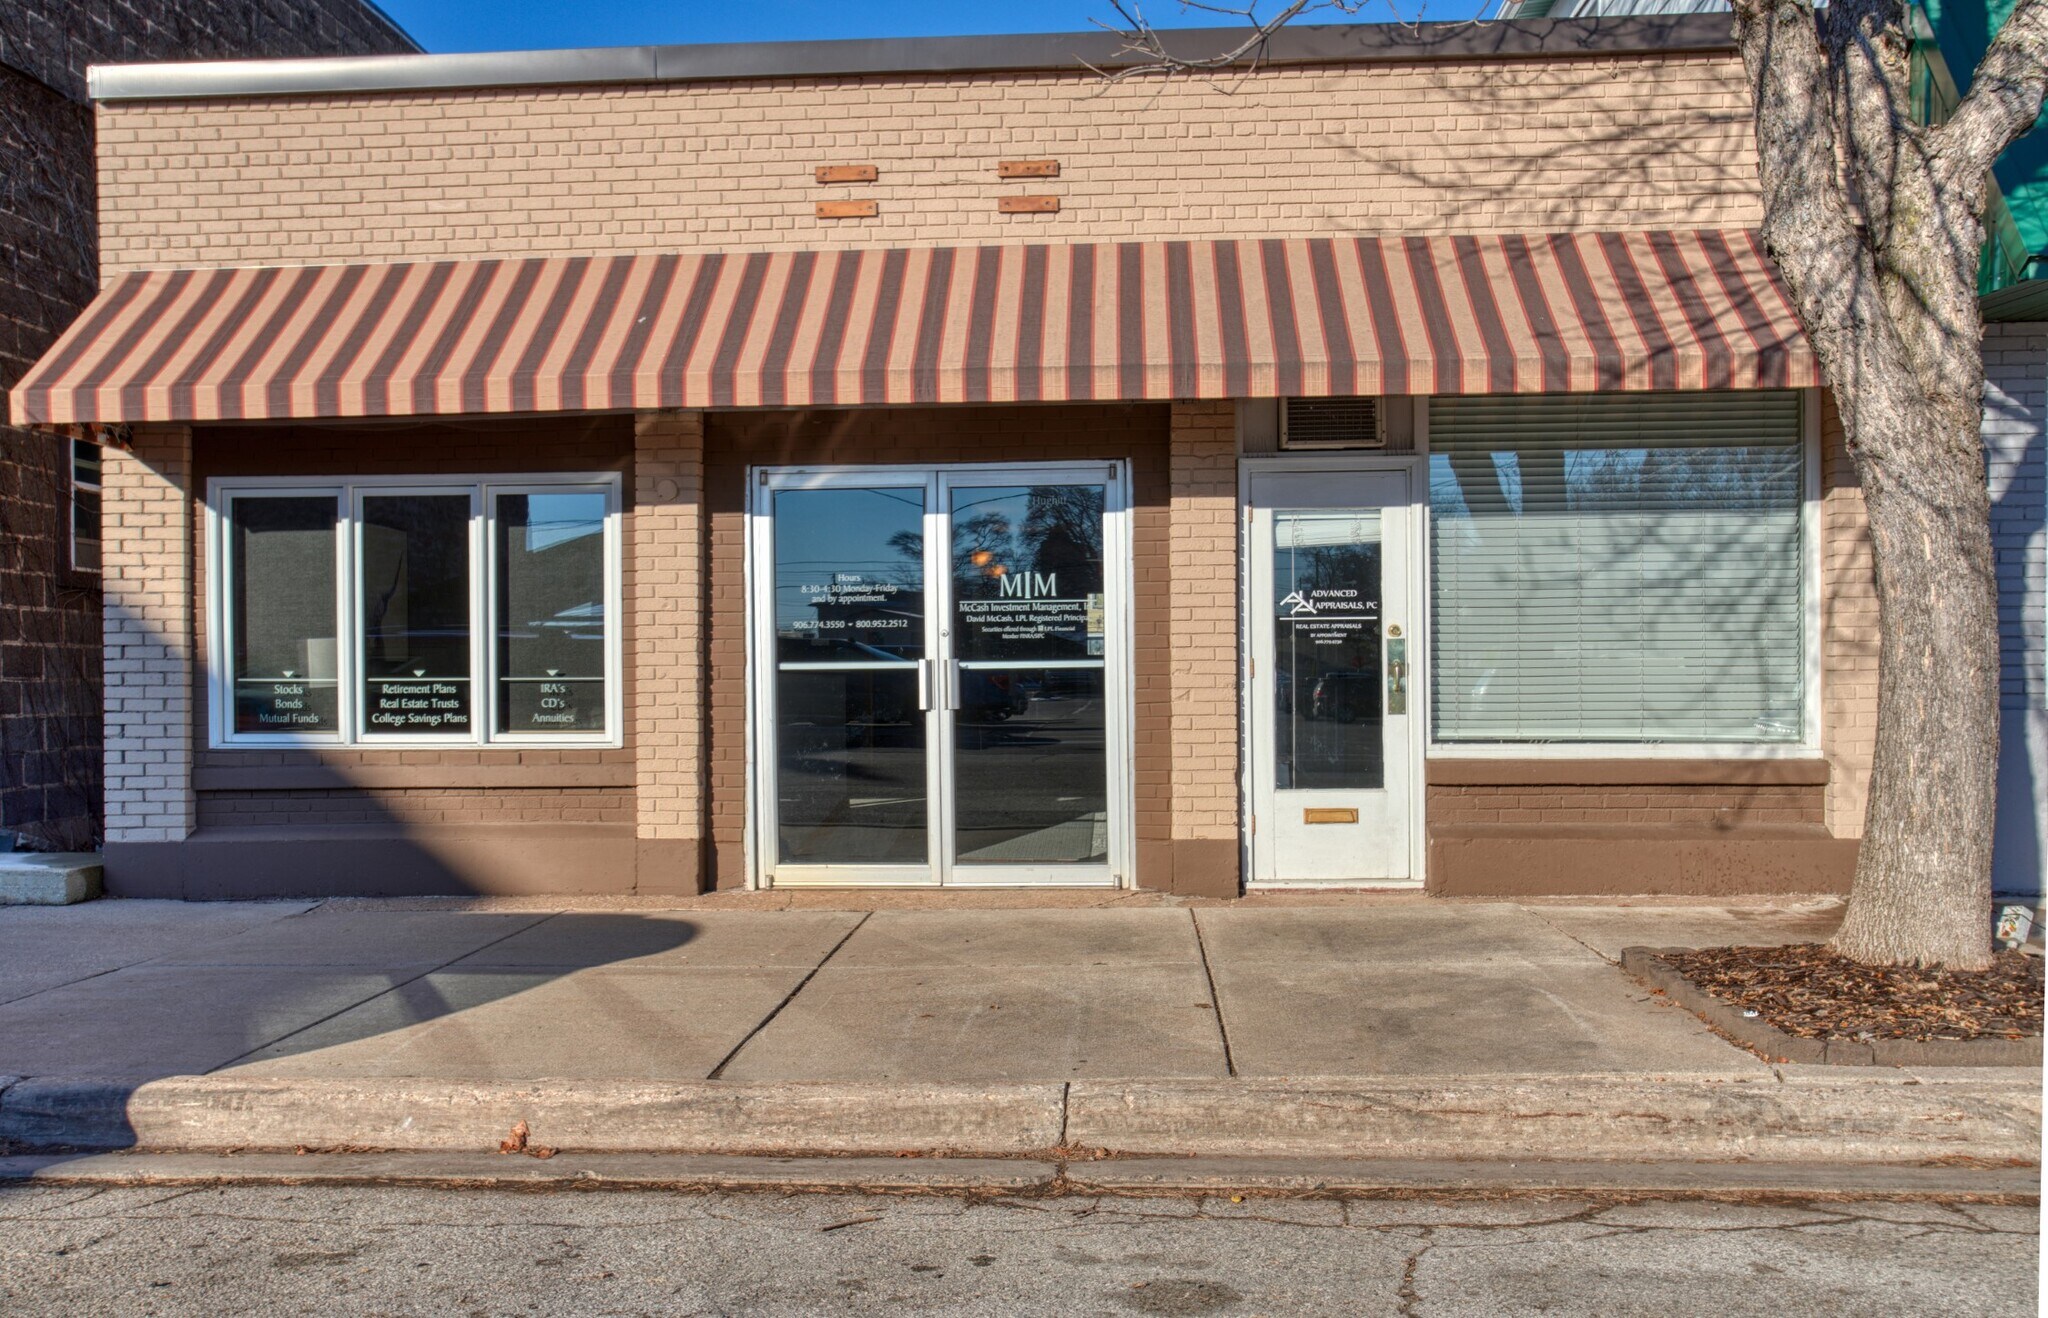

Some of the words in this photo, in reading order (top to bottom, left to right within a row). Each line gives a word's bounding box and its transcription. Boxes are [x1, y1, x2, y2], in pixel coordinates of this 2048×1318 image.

[838, 574, 861, 582] Hours
[801, 585, 841, 593] 8:30-4:30
[843, 584, 898, 595] Monday-Friday
[811, 595, 825, 603] and
[828, 595, 838, 605] by
[838, 594, 887, 605] appointment.
[959, 603, 989, 612] McCash
[991, 602, 1030, 612] Investment
[1032, 602, 1081, 613] Management,
[1315, 601, 1364, 610] APPRAISALS,
[1366, 601, 1378, 609] PC
[1029, 614, 1062, 623] Registered
[793, 620, 845, 629] 906.774.3550
[855, 619, 908, 628] 800.952.2512
[1020, 625, 1037, 633] through
[274, 684, 303, 694] Stocks
[382, 684, 430, 694] Retirement
[432, 683, 456, 694] Plans
[540, 683, 566, 693] IRA's
[275, 698, 303, 709] Bonds
[380, 698, 399, 708] Real
[401, 698, 428, 708] Estate
[431, 698, 459, 708] Trusts
[541, 698, 565, 708] CD's
[259, 713, 290, 723] Mutual
[292, 712, 319, 723] Funds
[371, 712, 406, 726] College
[408, 712, 441, 726] Savings
[443, 712, 467, 723] Plans
[532, 713, 575, 723] Annuities
